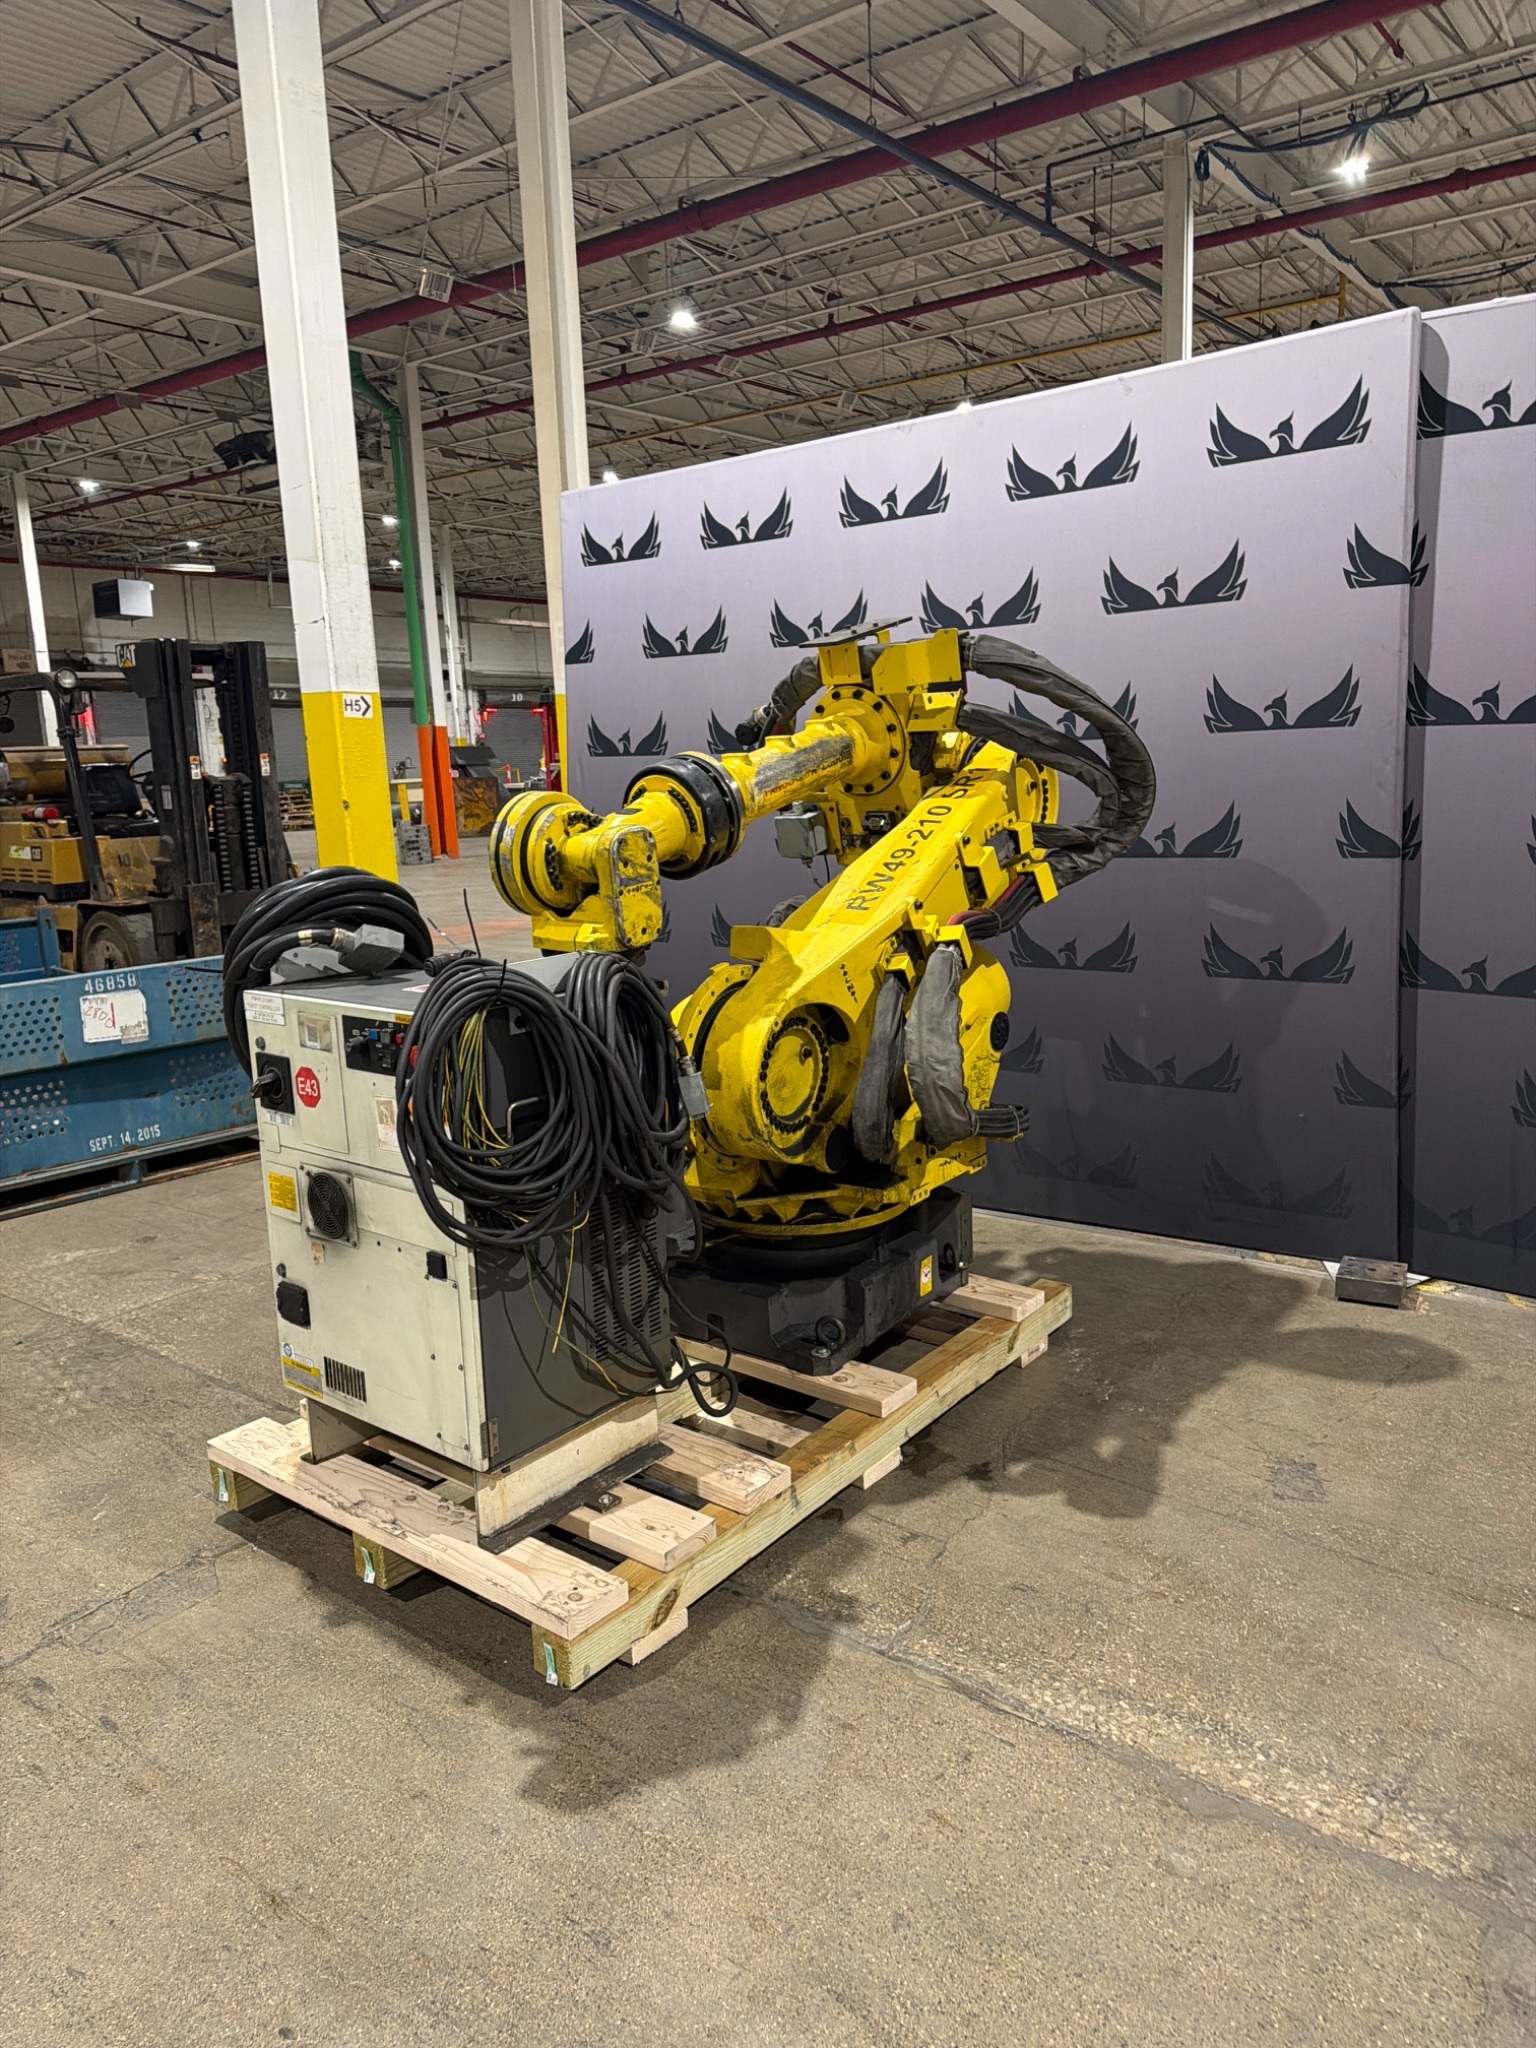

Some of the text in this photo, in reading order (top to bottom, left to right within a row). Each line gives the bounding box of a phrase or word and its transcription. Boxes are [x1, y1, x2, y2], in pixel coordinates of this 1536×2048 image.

[427, 290, 444, 299] S-10
[116, 644, 136, 668] CAT
[272, 689, 287, 700] 12
[511, 693, 523, 702] 10
[845, 805, 952, 910] RW49-210
[84, 973, 136, 993] 46858
[298, 1077, 319, 1097] E43
[137, 1124, 161, 1141] 2015
